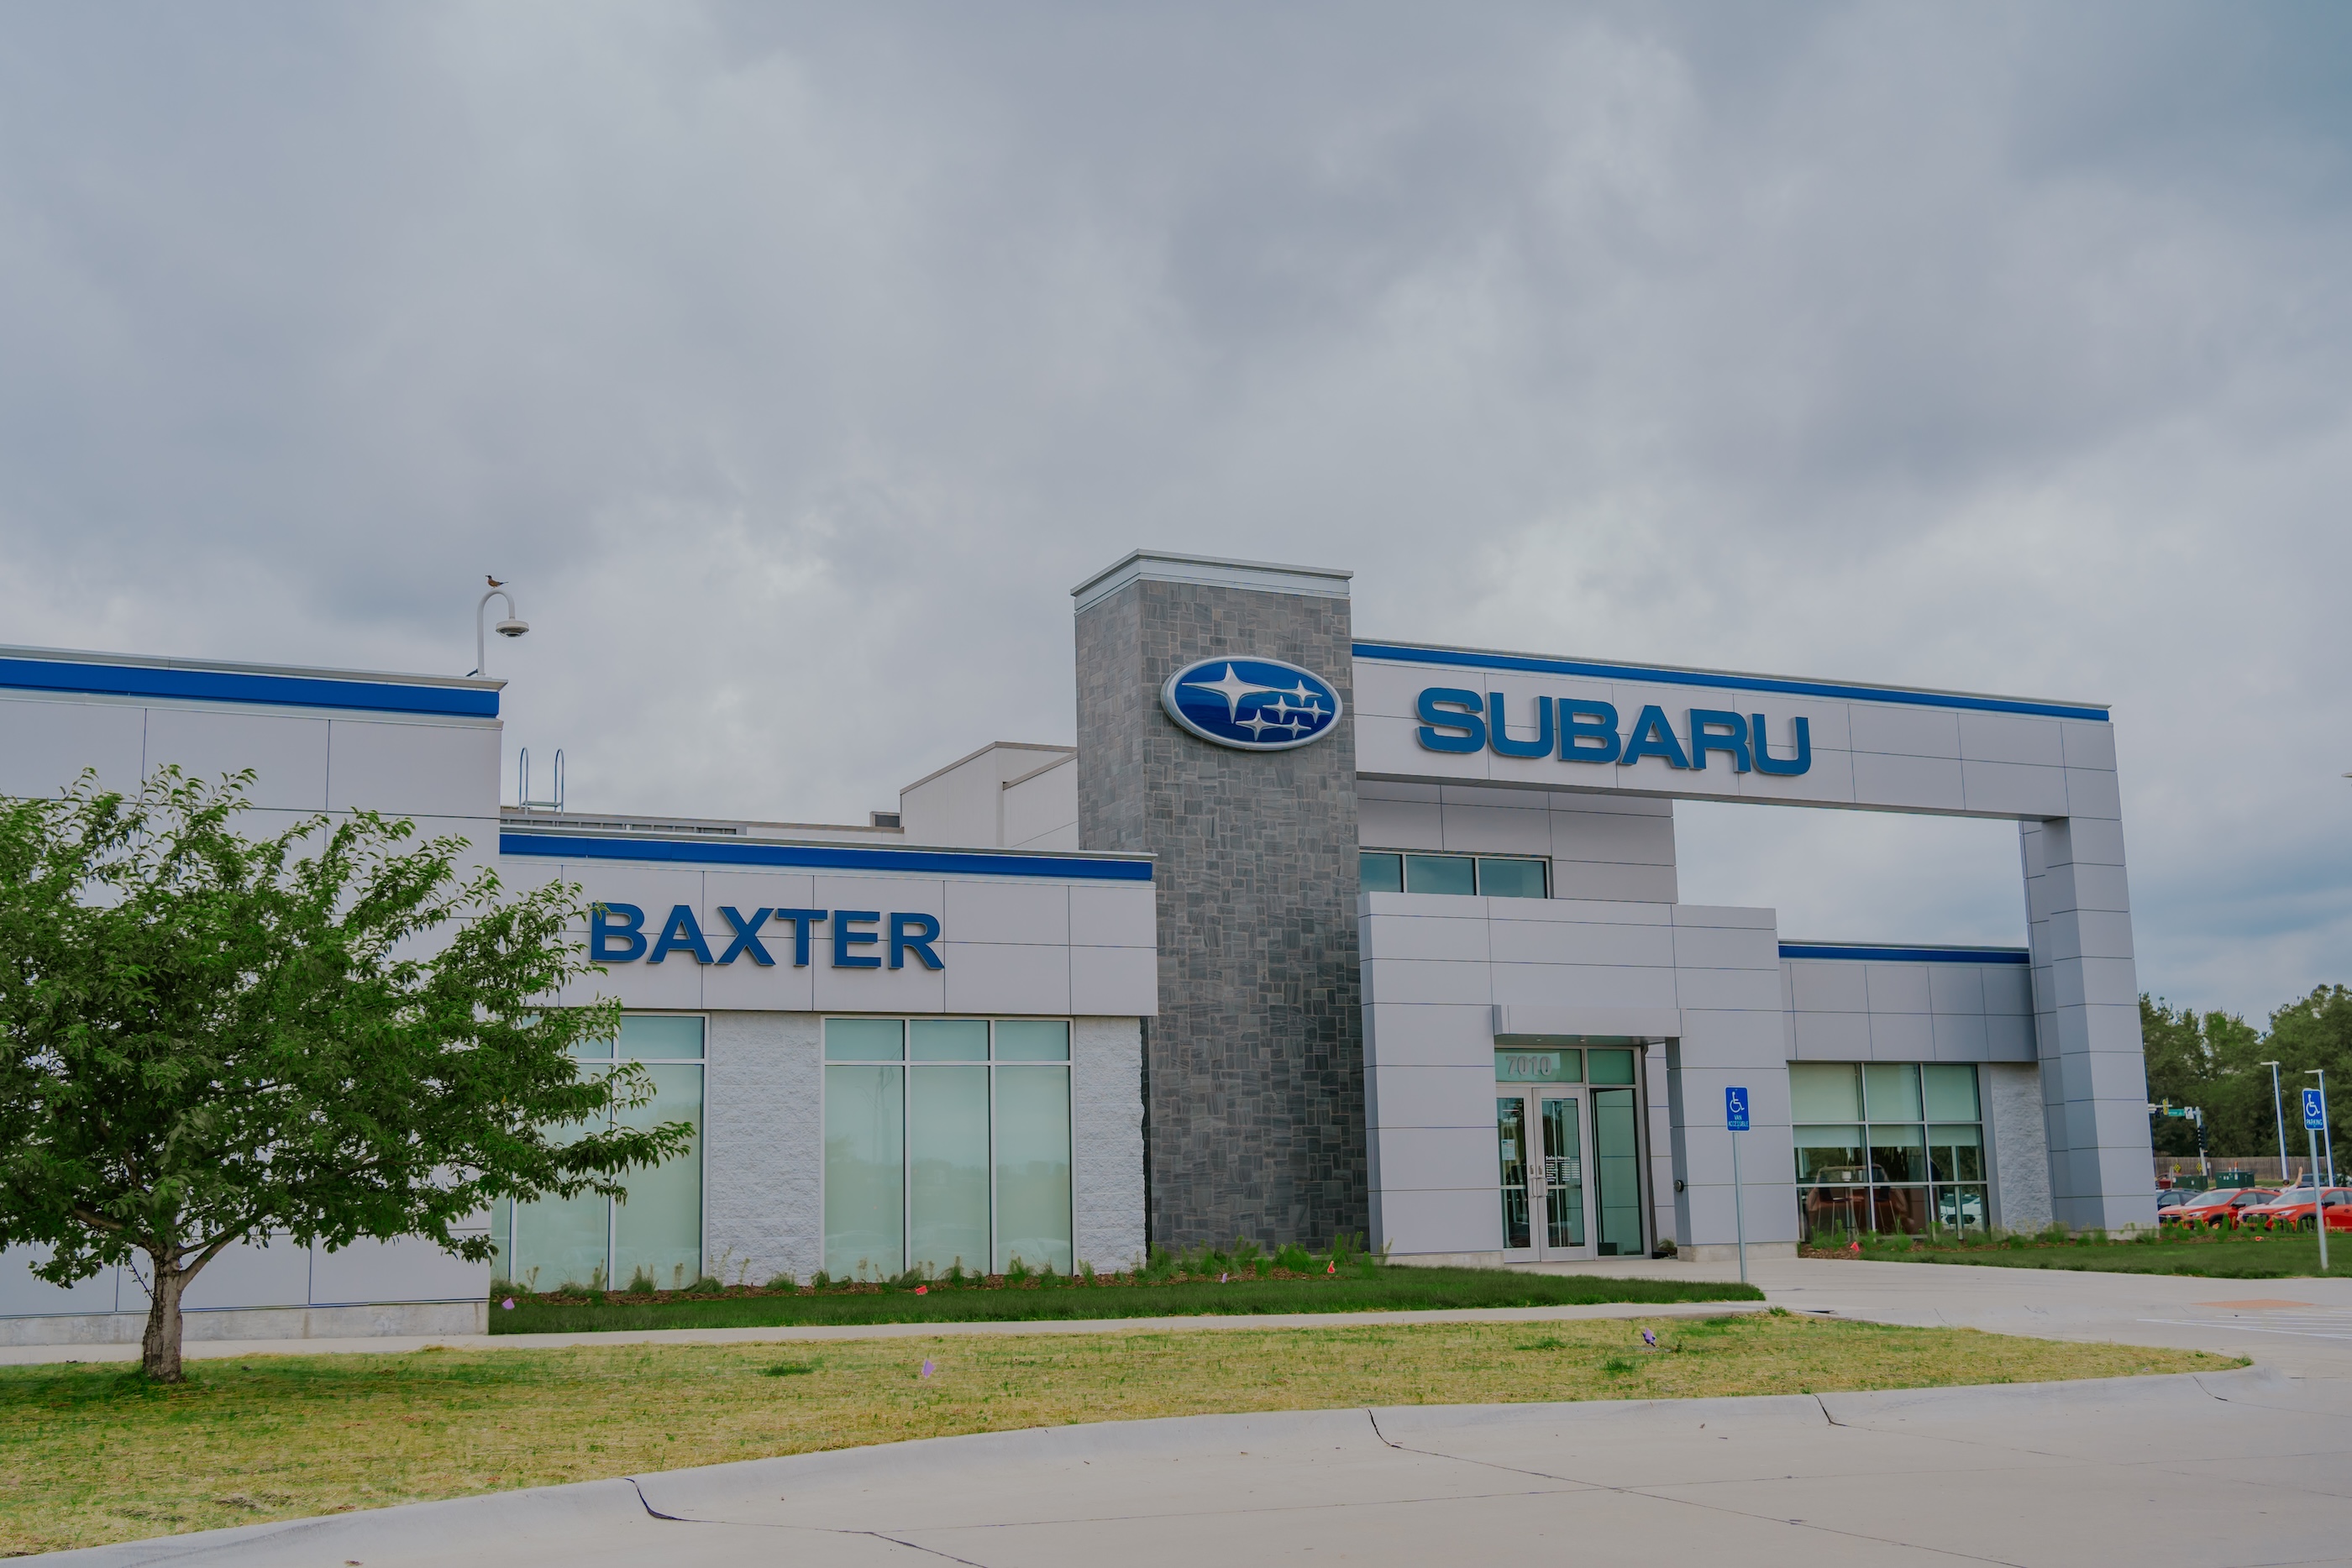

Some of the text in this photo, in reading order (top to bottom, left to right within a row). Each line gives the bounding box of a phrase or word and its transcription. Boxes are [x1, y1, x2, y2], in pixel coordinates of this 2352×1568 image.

[1415, 687, 1812, 776] SUBARU
[590, 902, 945, 970] BAXTER
[1505, 1056, 1552, 1076] 7010
